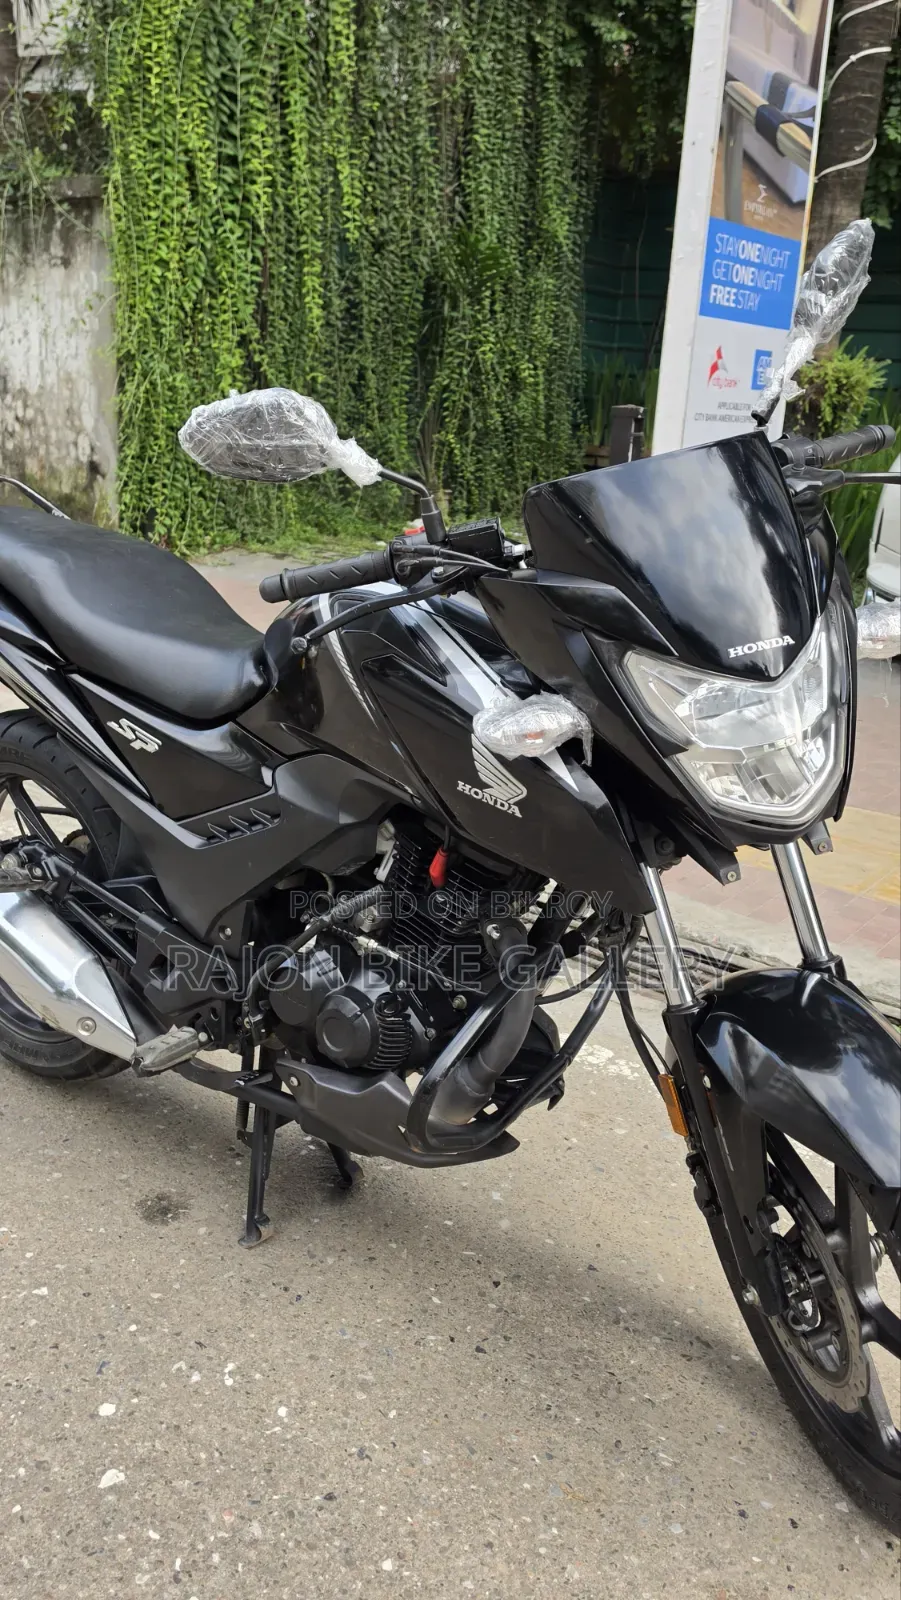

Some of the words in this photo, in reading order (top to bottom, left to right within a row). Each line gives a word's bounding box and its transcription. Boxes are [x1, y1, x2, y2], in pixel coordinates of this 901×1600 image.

[709, 283, 738, 308] FREE
[737, 289, 761, 312] STAY
[727, 635, 796, 659] HONDA
[106, 717, 163, 754] SP
[456, 780, 523, 818] HONDA
